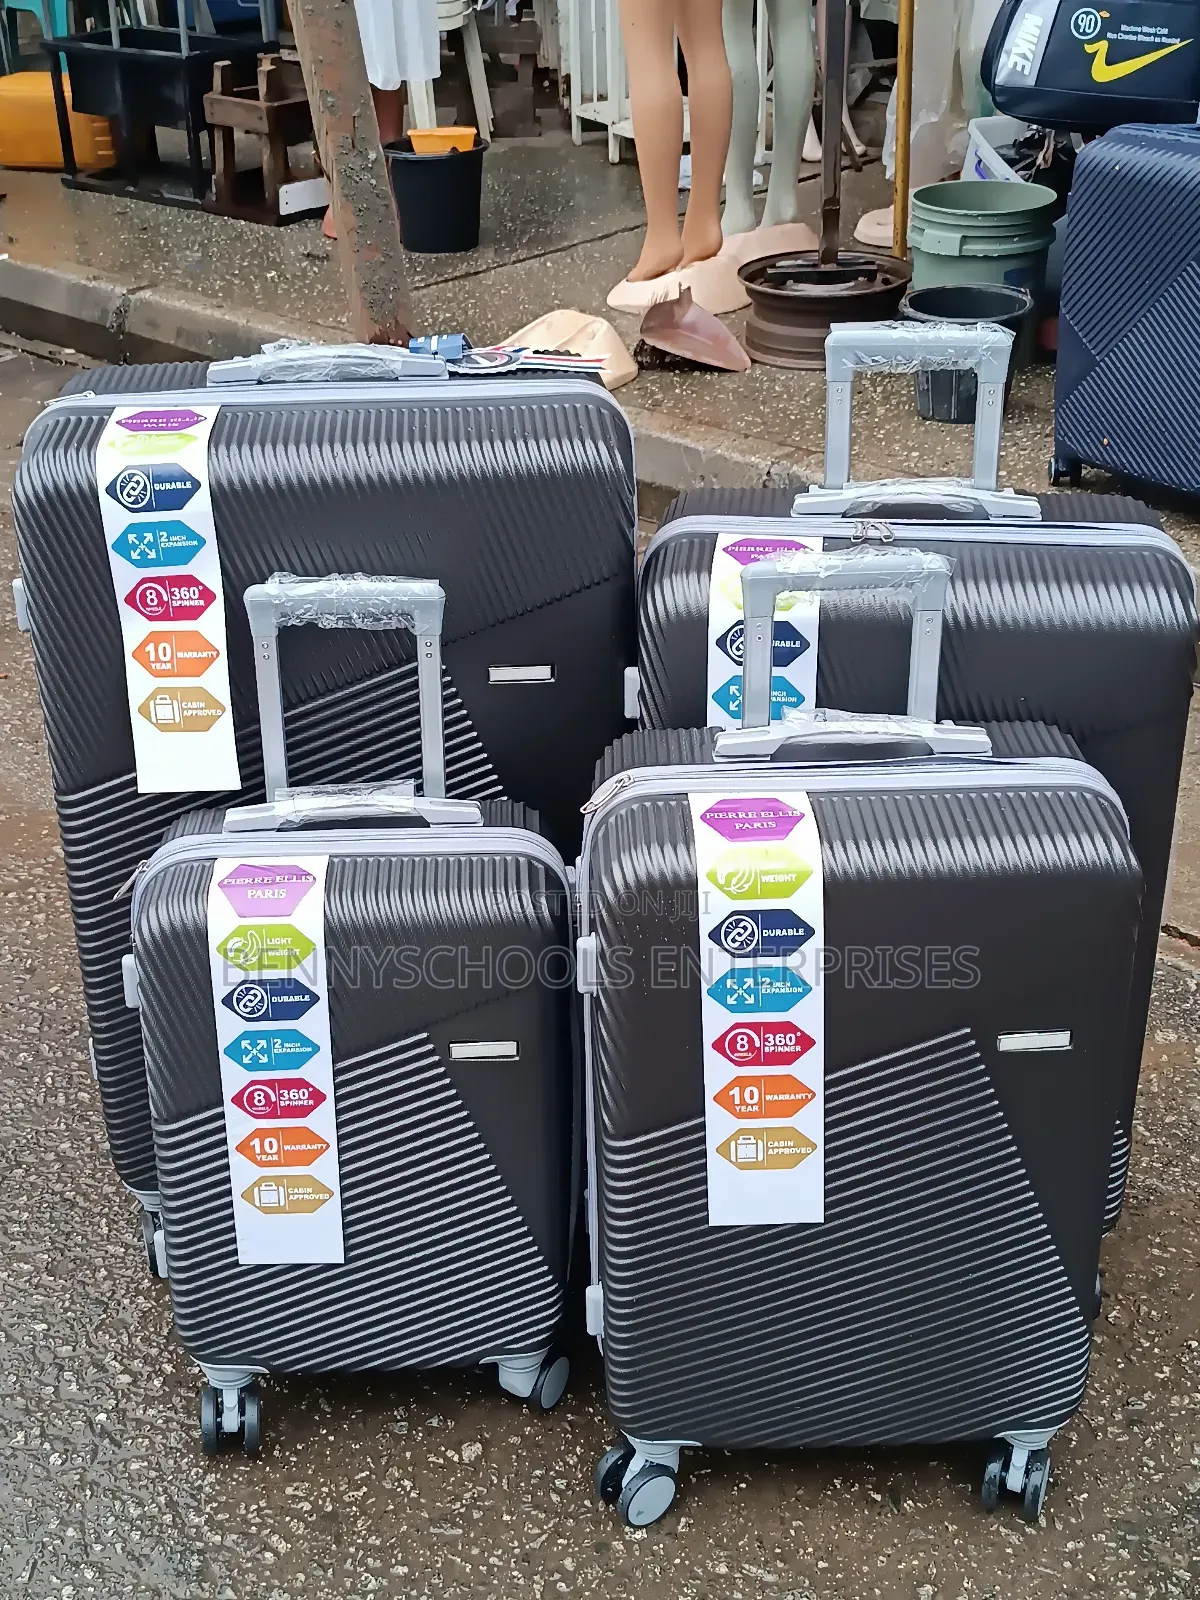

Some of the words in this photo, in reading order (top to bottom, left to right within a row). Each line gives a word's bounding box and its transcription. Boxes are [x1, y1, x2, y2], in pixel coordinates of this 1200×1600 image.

[1078, 14, 1095, 33] 90
[154, 481, 192, 490] DURABLE
[160, 532, 168, 542] 2
[161, 540, 198, 548] EXPANSION
[146, 590, 158, 606] 8
[145, 642, 171, 662] 10
[760, 810, 801, 818] ELLIS
[734, 822, 777, 830] PARIS
[223, 876, 273, 885] PIERRE
[275, 875, 314, 883] ELLIS
[761, 874, 797, 883] WEIGHT
[248, 889, 286, 899] PARIS
[763, 928, 805, 936] DURABLE
[762, 977, 771, 987] 2
[274, 1039, 282, 1047] 2
[736, 1034, 748, 1051] 8
[254, 1091, 266, 1106] 8
[729, 1086, 759, 1105] 10
[250, 1137, 278, 1154] 10
[768, 1147, 813, 1155] APPROVED
